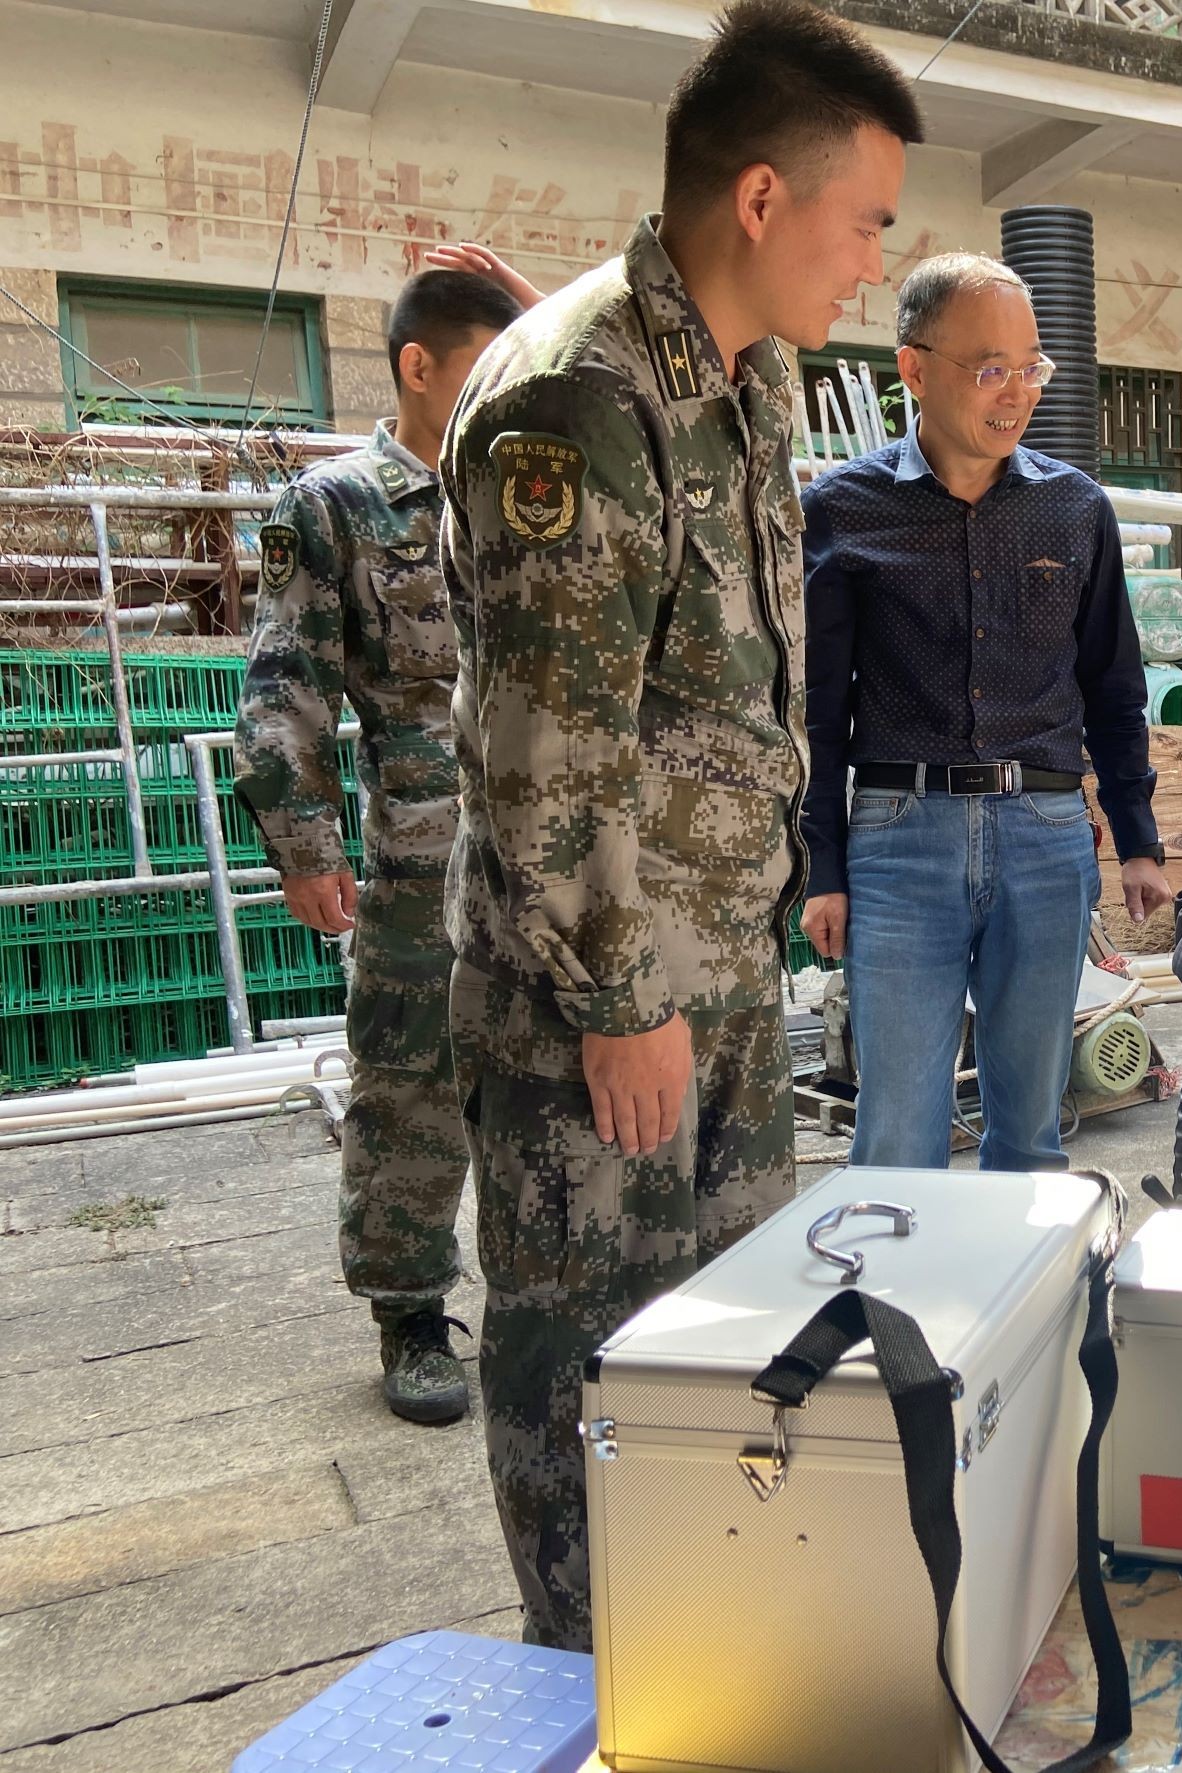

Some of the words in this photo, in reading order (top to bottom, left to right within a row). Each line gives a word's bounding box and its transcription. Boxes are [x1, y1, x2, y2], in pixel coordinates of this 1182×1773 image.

[502, 444, 578, 462] 中国人民解放军
[516, 459, 563, 474] 陆军
